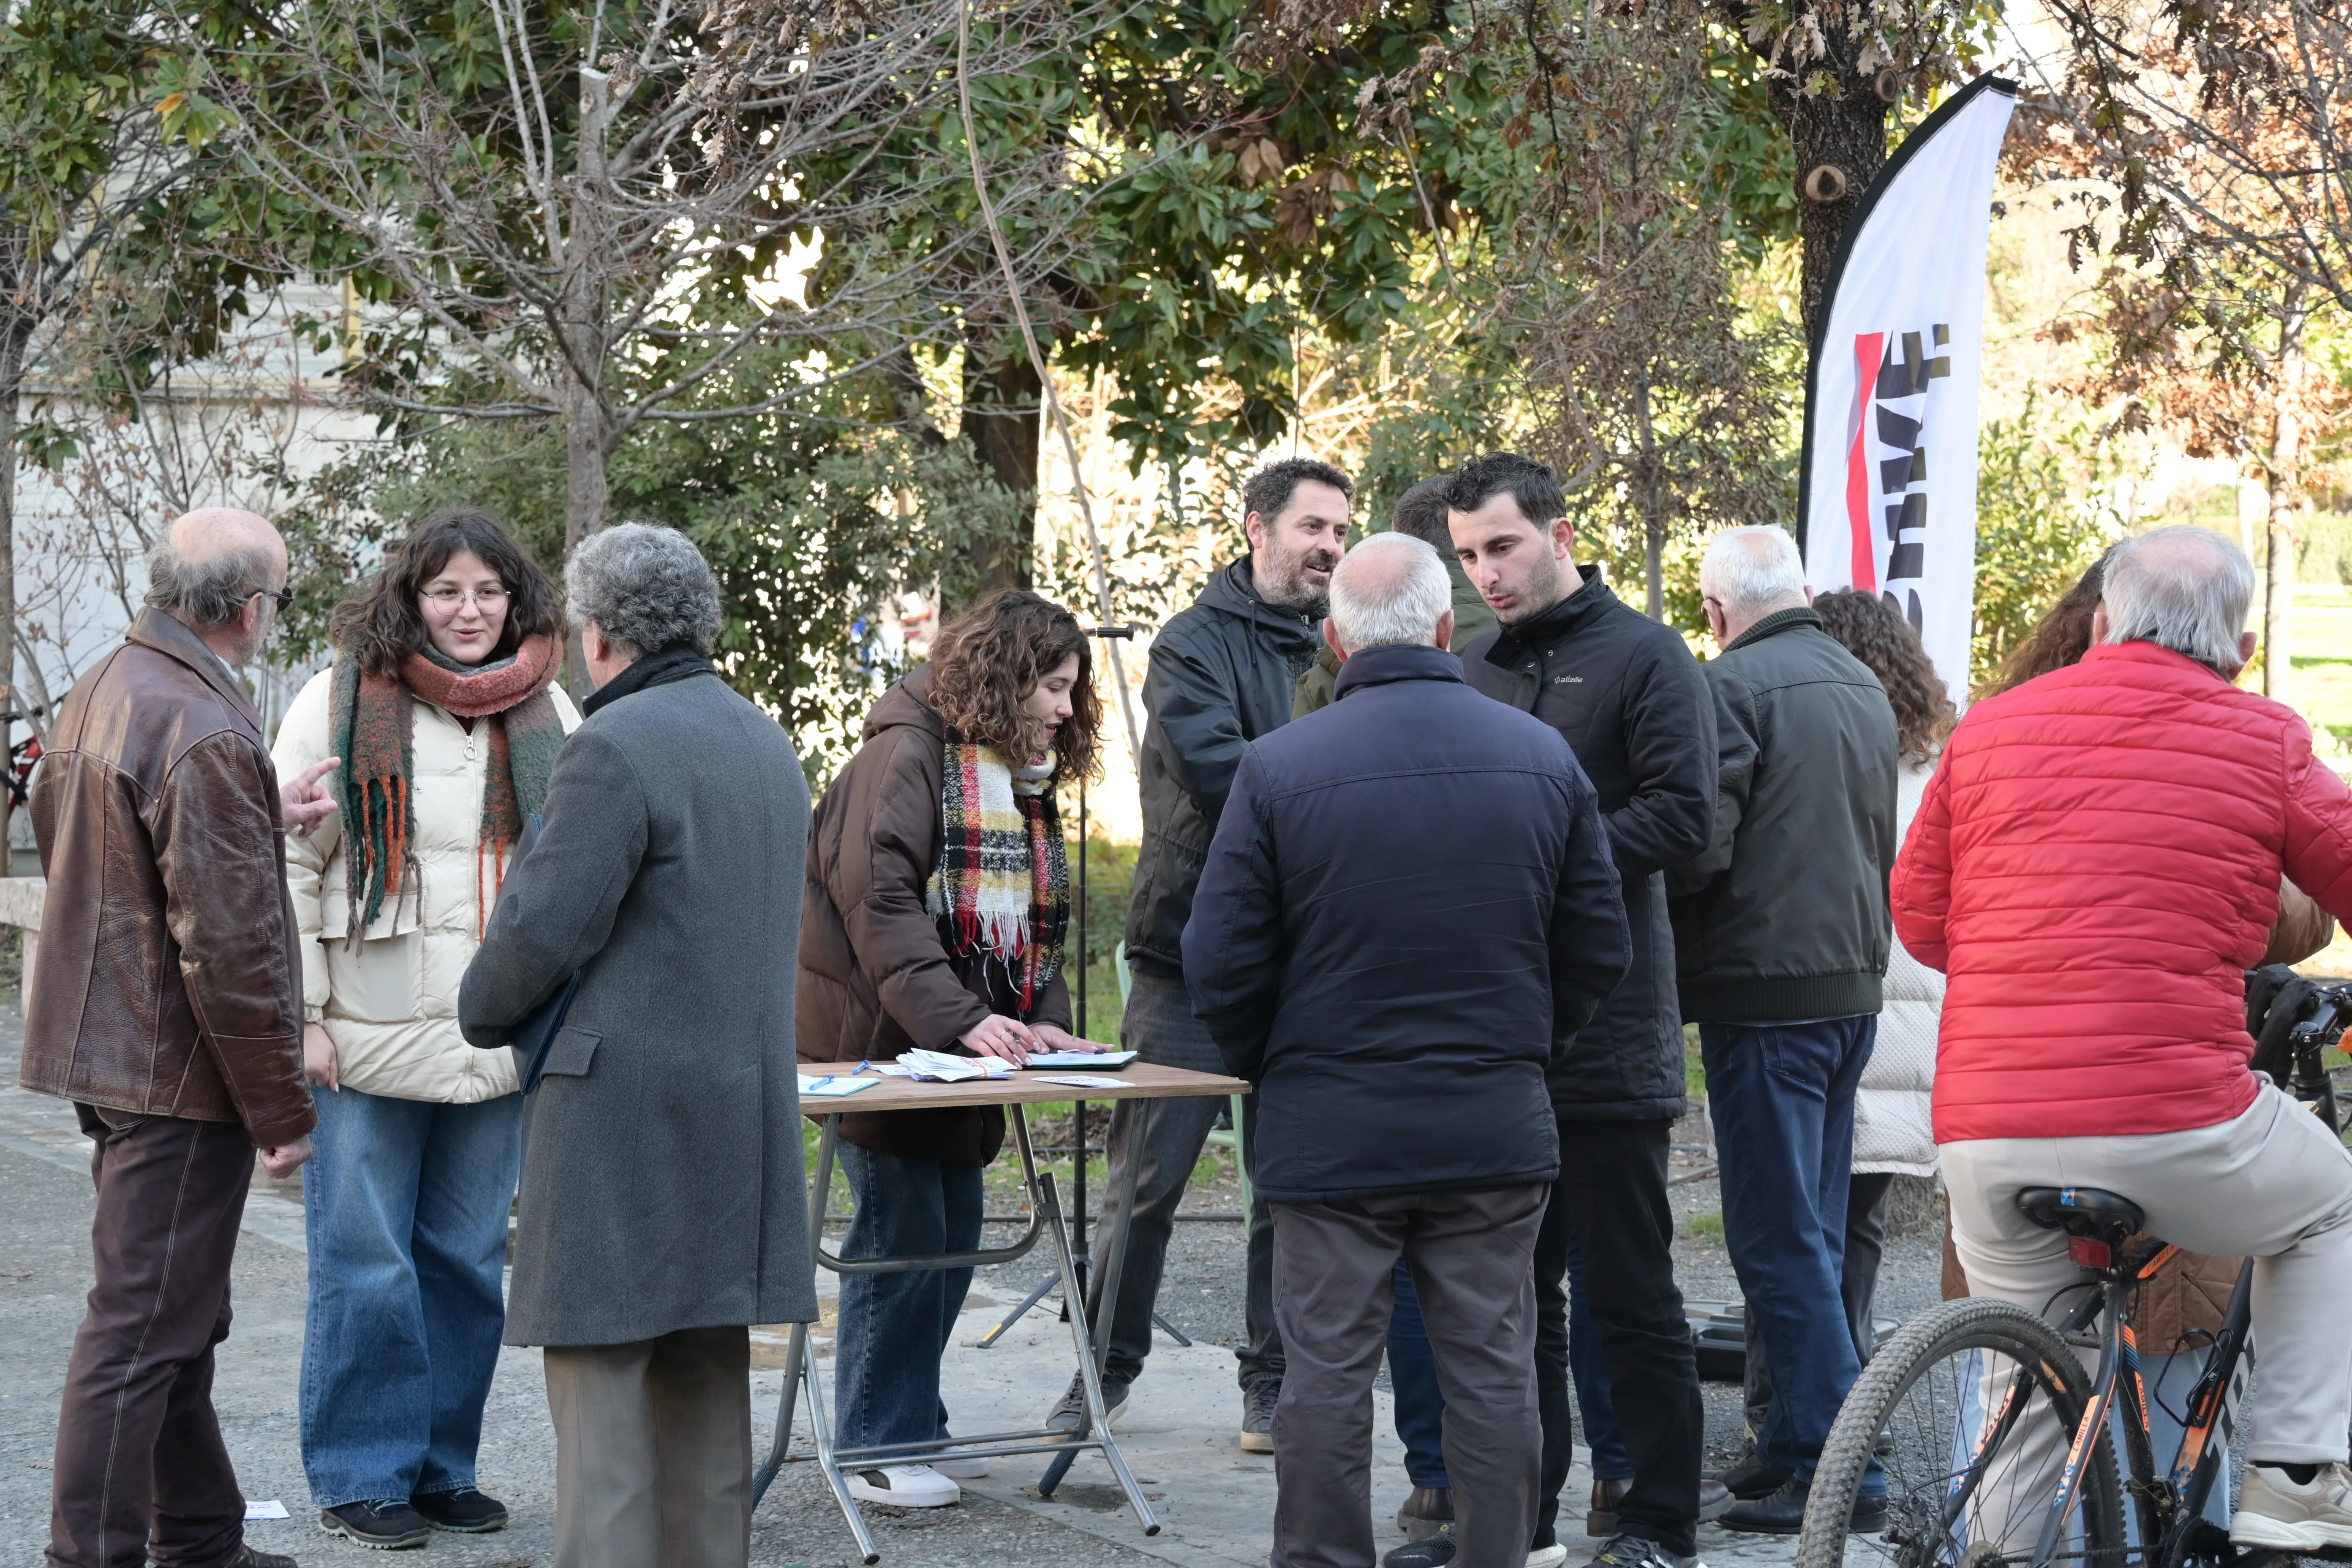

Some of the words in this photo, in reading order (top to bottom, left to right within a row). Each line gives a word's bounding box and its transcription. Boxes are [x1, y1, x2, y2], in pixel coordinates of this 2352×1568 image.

[2147, 1245, 2175, 1273] CAMILLA
[2138, 1380, 2149, 1428] CAMILLA
[2205, 1320, 2257, 1467] TOT
[2072, 1416, 2090, 1452] CAMILLA
